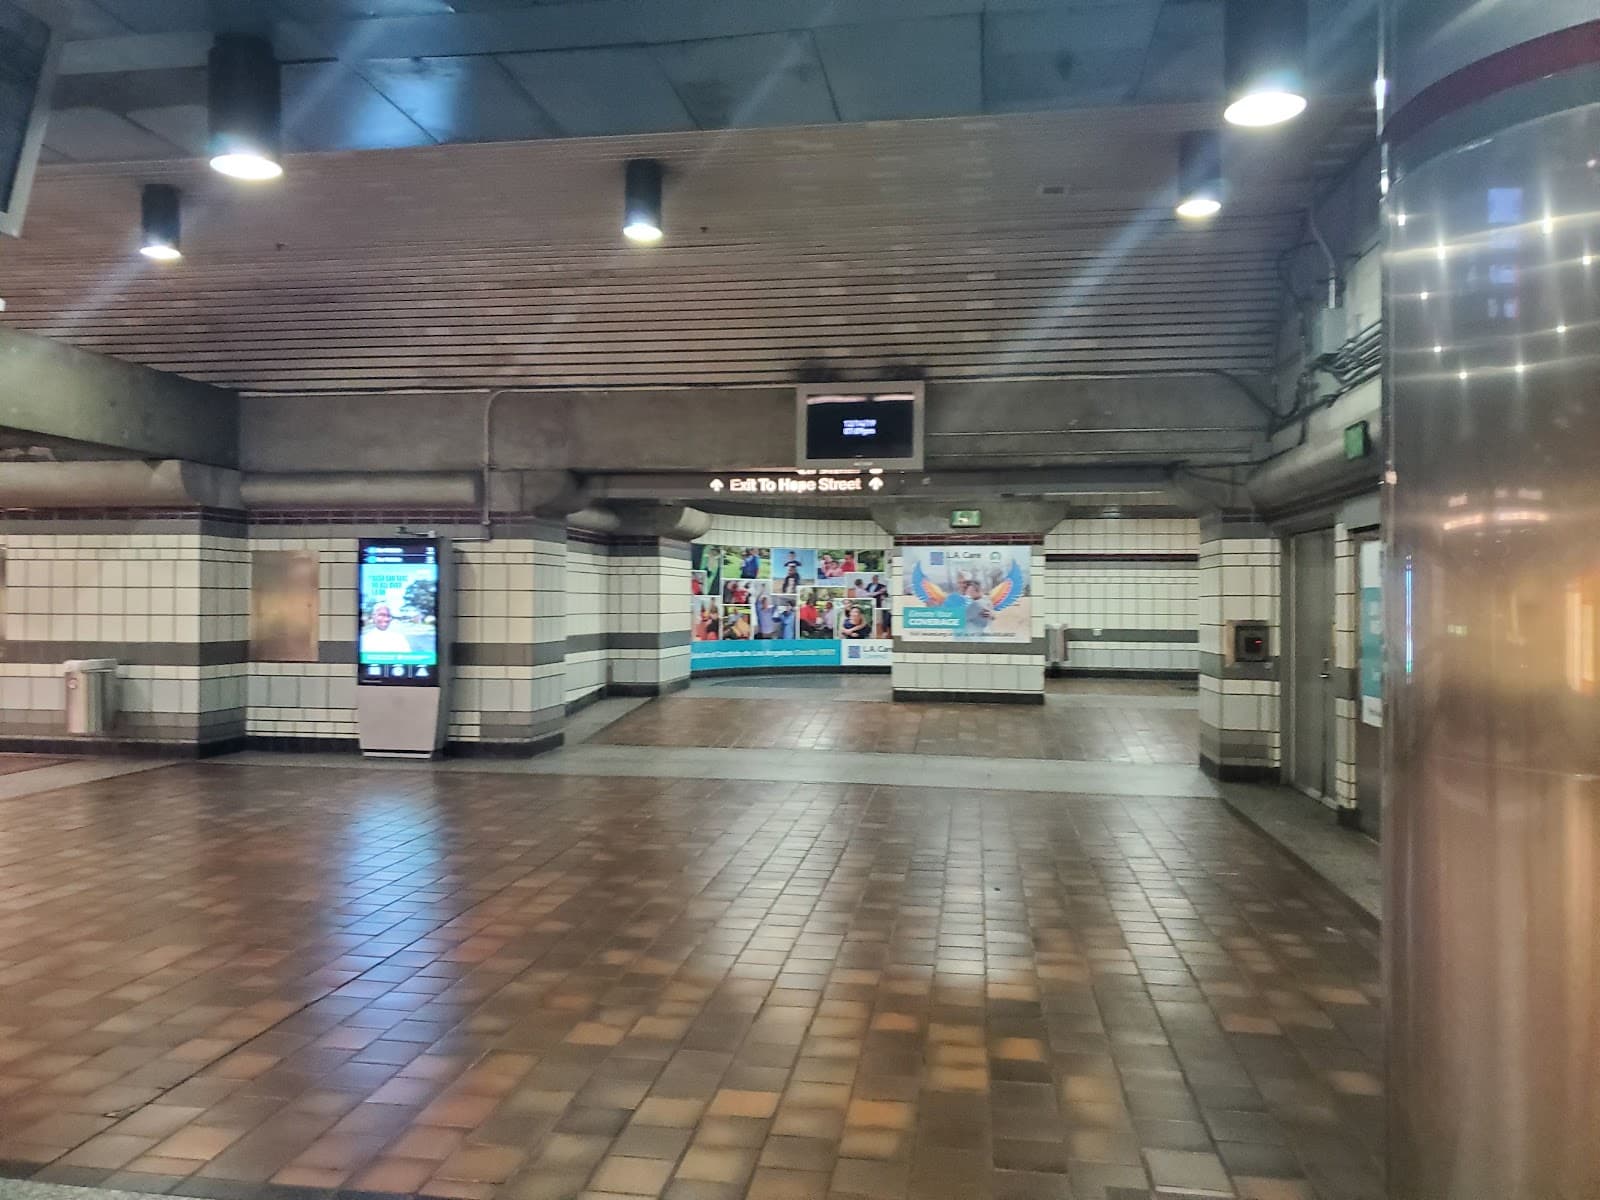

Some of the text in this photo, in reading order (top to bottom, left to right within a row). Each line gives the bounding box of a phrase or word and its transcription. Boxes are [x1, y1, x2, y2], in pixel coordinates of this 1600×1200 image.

[729, 477, 861, 495] Exit To Hope Street
[962, 551, 982, 559] Care
